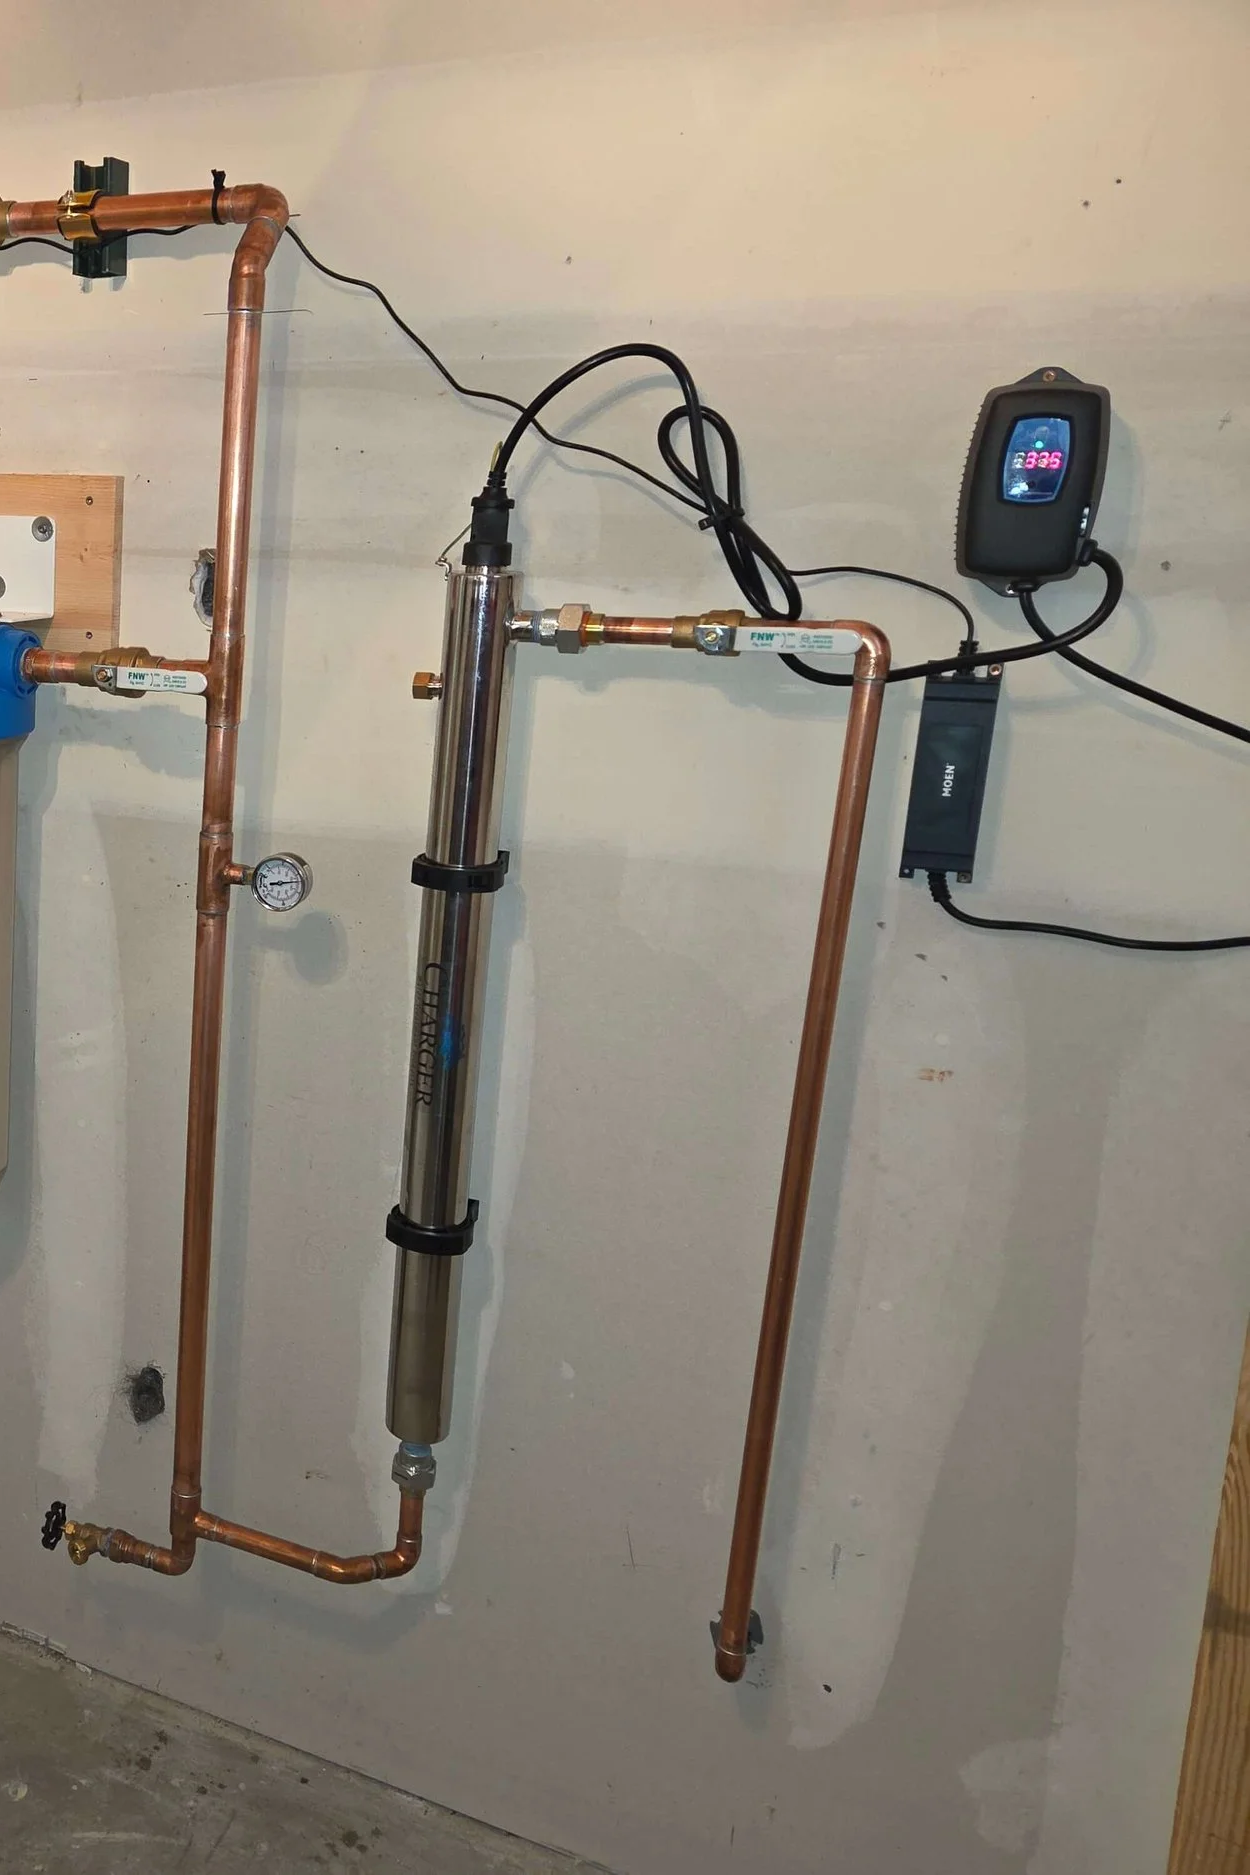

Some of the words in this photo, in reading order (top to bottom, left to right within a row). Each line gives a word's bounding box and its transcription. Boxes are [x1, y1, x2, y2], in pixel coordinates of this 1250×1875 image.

[750, 632, 775, 641] FNW
[128, 672, 146, 680] FNW
[942, 765, 956, 797] MOEN
[415, 962, 446, 1106] CHARGER
